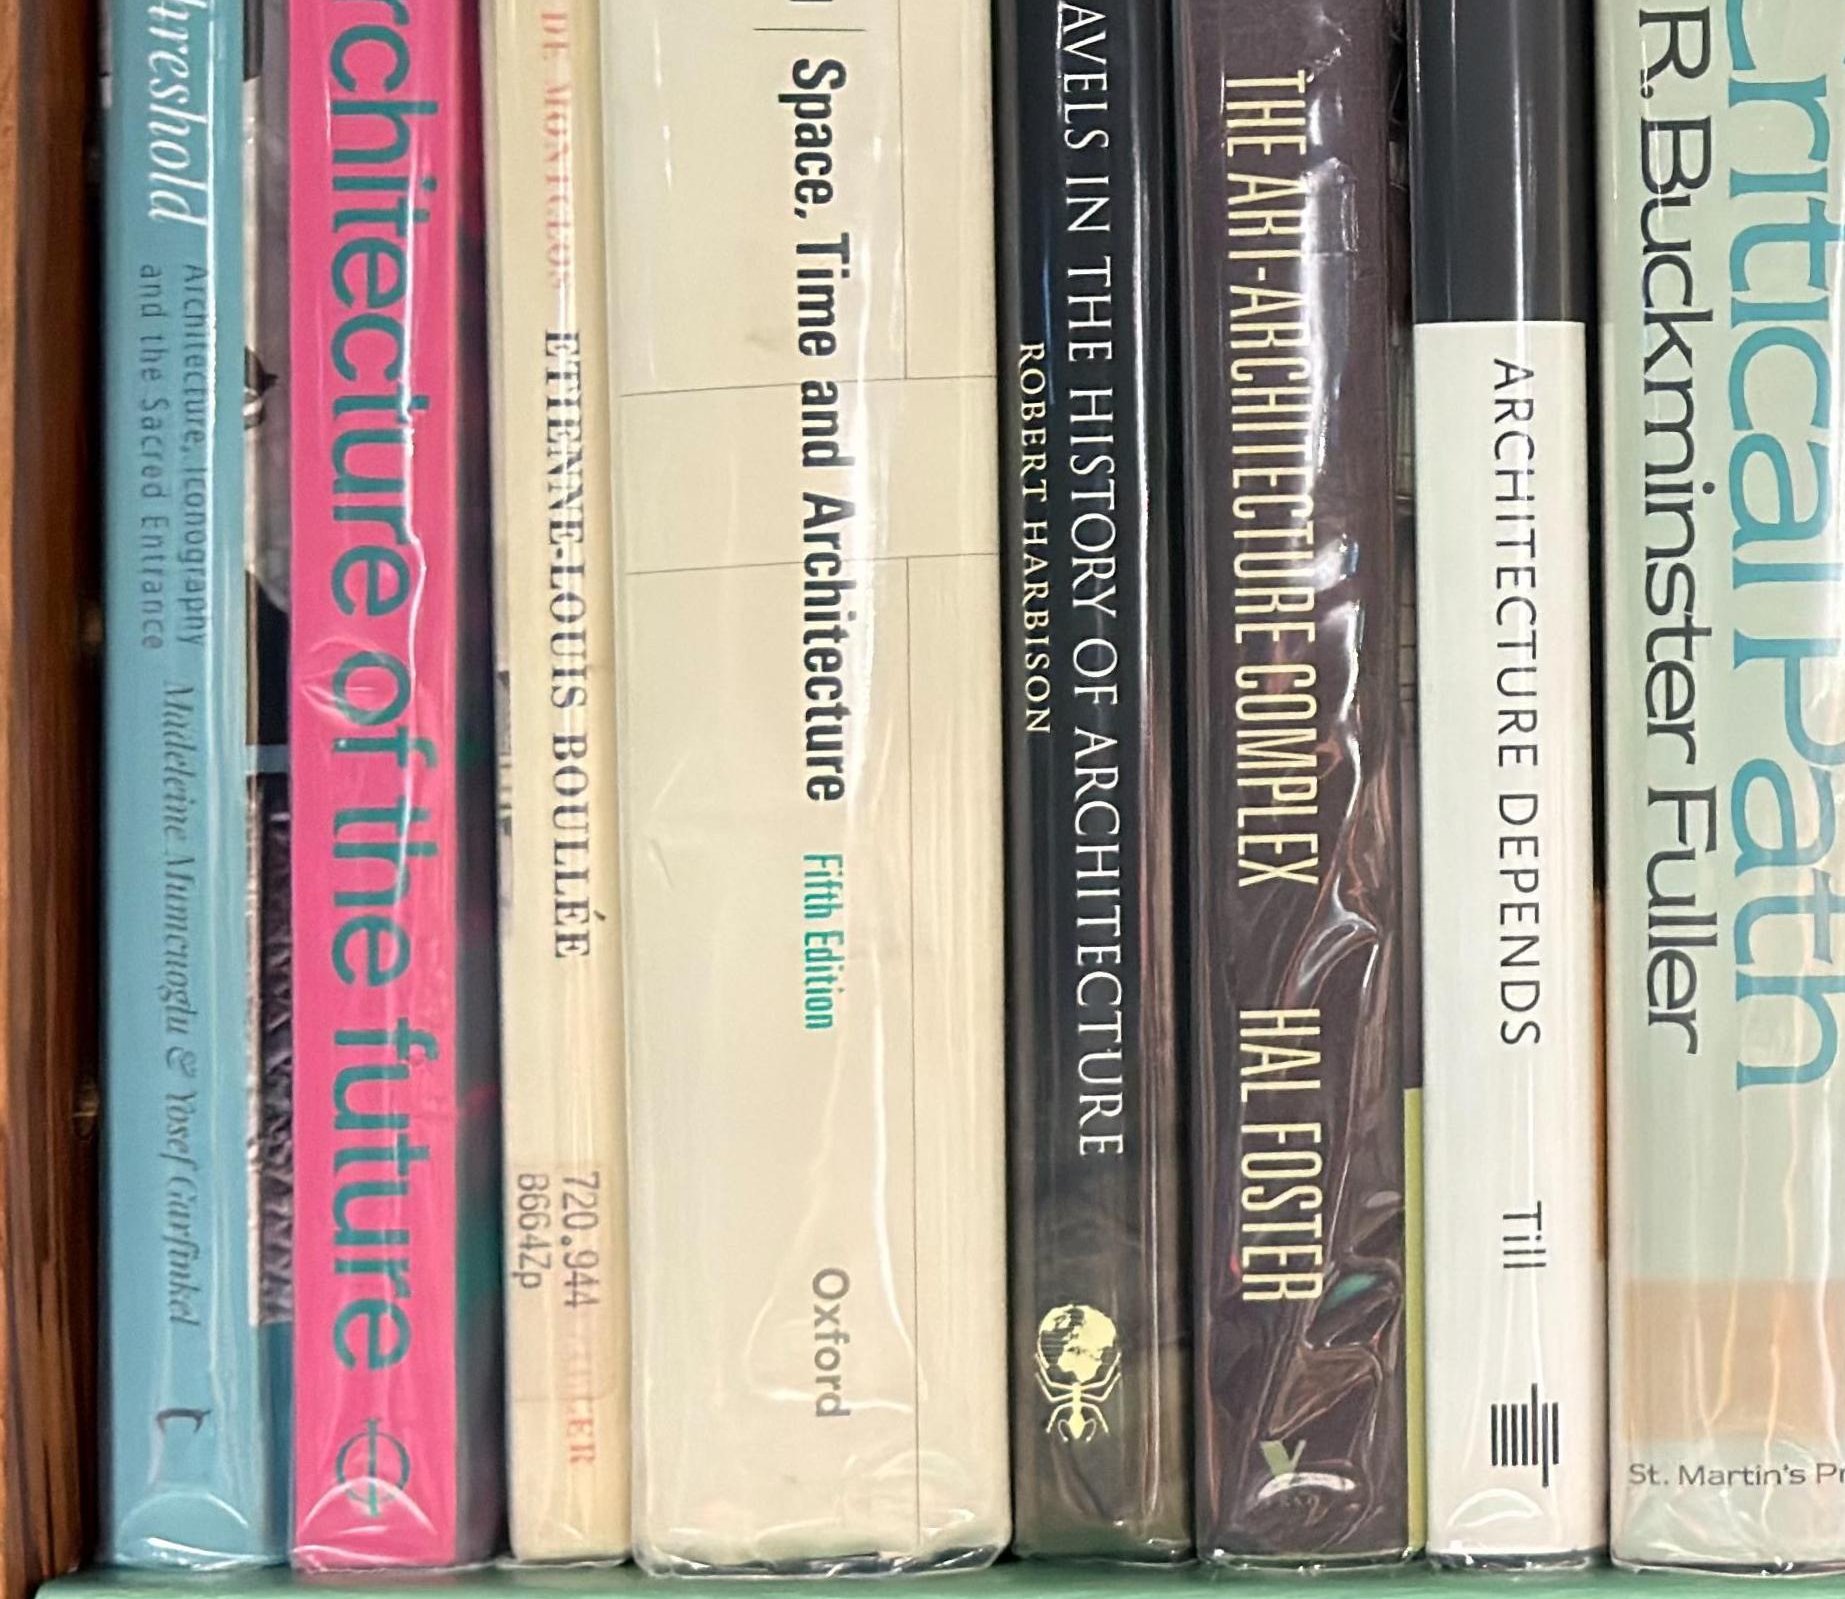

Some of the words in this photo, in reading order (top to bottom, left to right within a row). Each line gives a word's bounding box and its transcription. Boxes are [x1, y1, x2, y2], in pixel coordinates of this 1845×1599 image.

[540, 11, 570, 61] DE
[1639, 6, 1711, 99] R.
[778, 58, 847, 219] Space,
[1225, 69, 1306, 158] THE
[1065, 176, 1111, 233] IN
[139, 264, 169, 318] and
[139, 335, 169, 383] the
[180, 264, 210, 452] Architecture,
[797, 232, 851, 358] Time
[1066, 256, 1113, 363] THE
[139, 398, 169, 498] Sacred
[800, 380, 857, 468] and
[1019, 342, 1048, 502] ROBERT
[1226, 172, 1316, 645] ART-ARCHITECTURE
[1640, 114, 1716, 765] Buckminster
[176, 466, 210, 645] Iconography
[545, 328, 588, 709] ETIENNE-LOUIS
[1068, 388, 1118, 617] HISTORY
[1494, 357, 1539, 768] ARCHITECTURE
[139, 515, 169, 651] Entrance
[801, 492, 858, 801] Architecture
[1022, 520, 1051, 734] HARBISON
[331, 651, 438, 768] of
[1072, 637, 1118, 705] OF
[160, 680, 197, 843] Madeleine
[1236, 662, 1319, 888] COMPLEX
[331, 802, 438, 988] the
[550, 731, 607, 959] BOULLÉE
[803, 854, 844, 919] Fifth
[1498, 792, 1541, 1046] DEPENDS
[1646, 785, 1718, 1054] Fuller
[803, 930, 845, 1030] Edition
[1073, 726, 1124, 1156] ARCHITECTURE
[158, 1090, 197, 1163] Yosef
[167, 1046, 196, 1078] &
[1238, 1007, 1322, 1104] HAL
[166, 1174, 201, 1327] Garfinkel
[332, 1018, 439, 1370] future
[559, 1170, 599, 1310] 720.944
[1239, 1120, 1323, 1302] FOSTER
[1502, 1200, 1547, 1270] Till
[812, 1267, 852, 1418] Oxford
[1628, 1462, 1671, 1487] St.
[1677, 1460, 1807, 1489] Martin's
